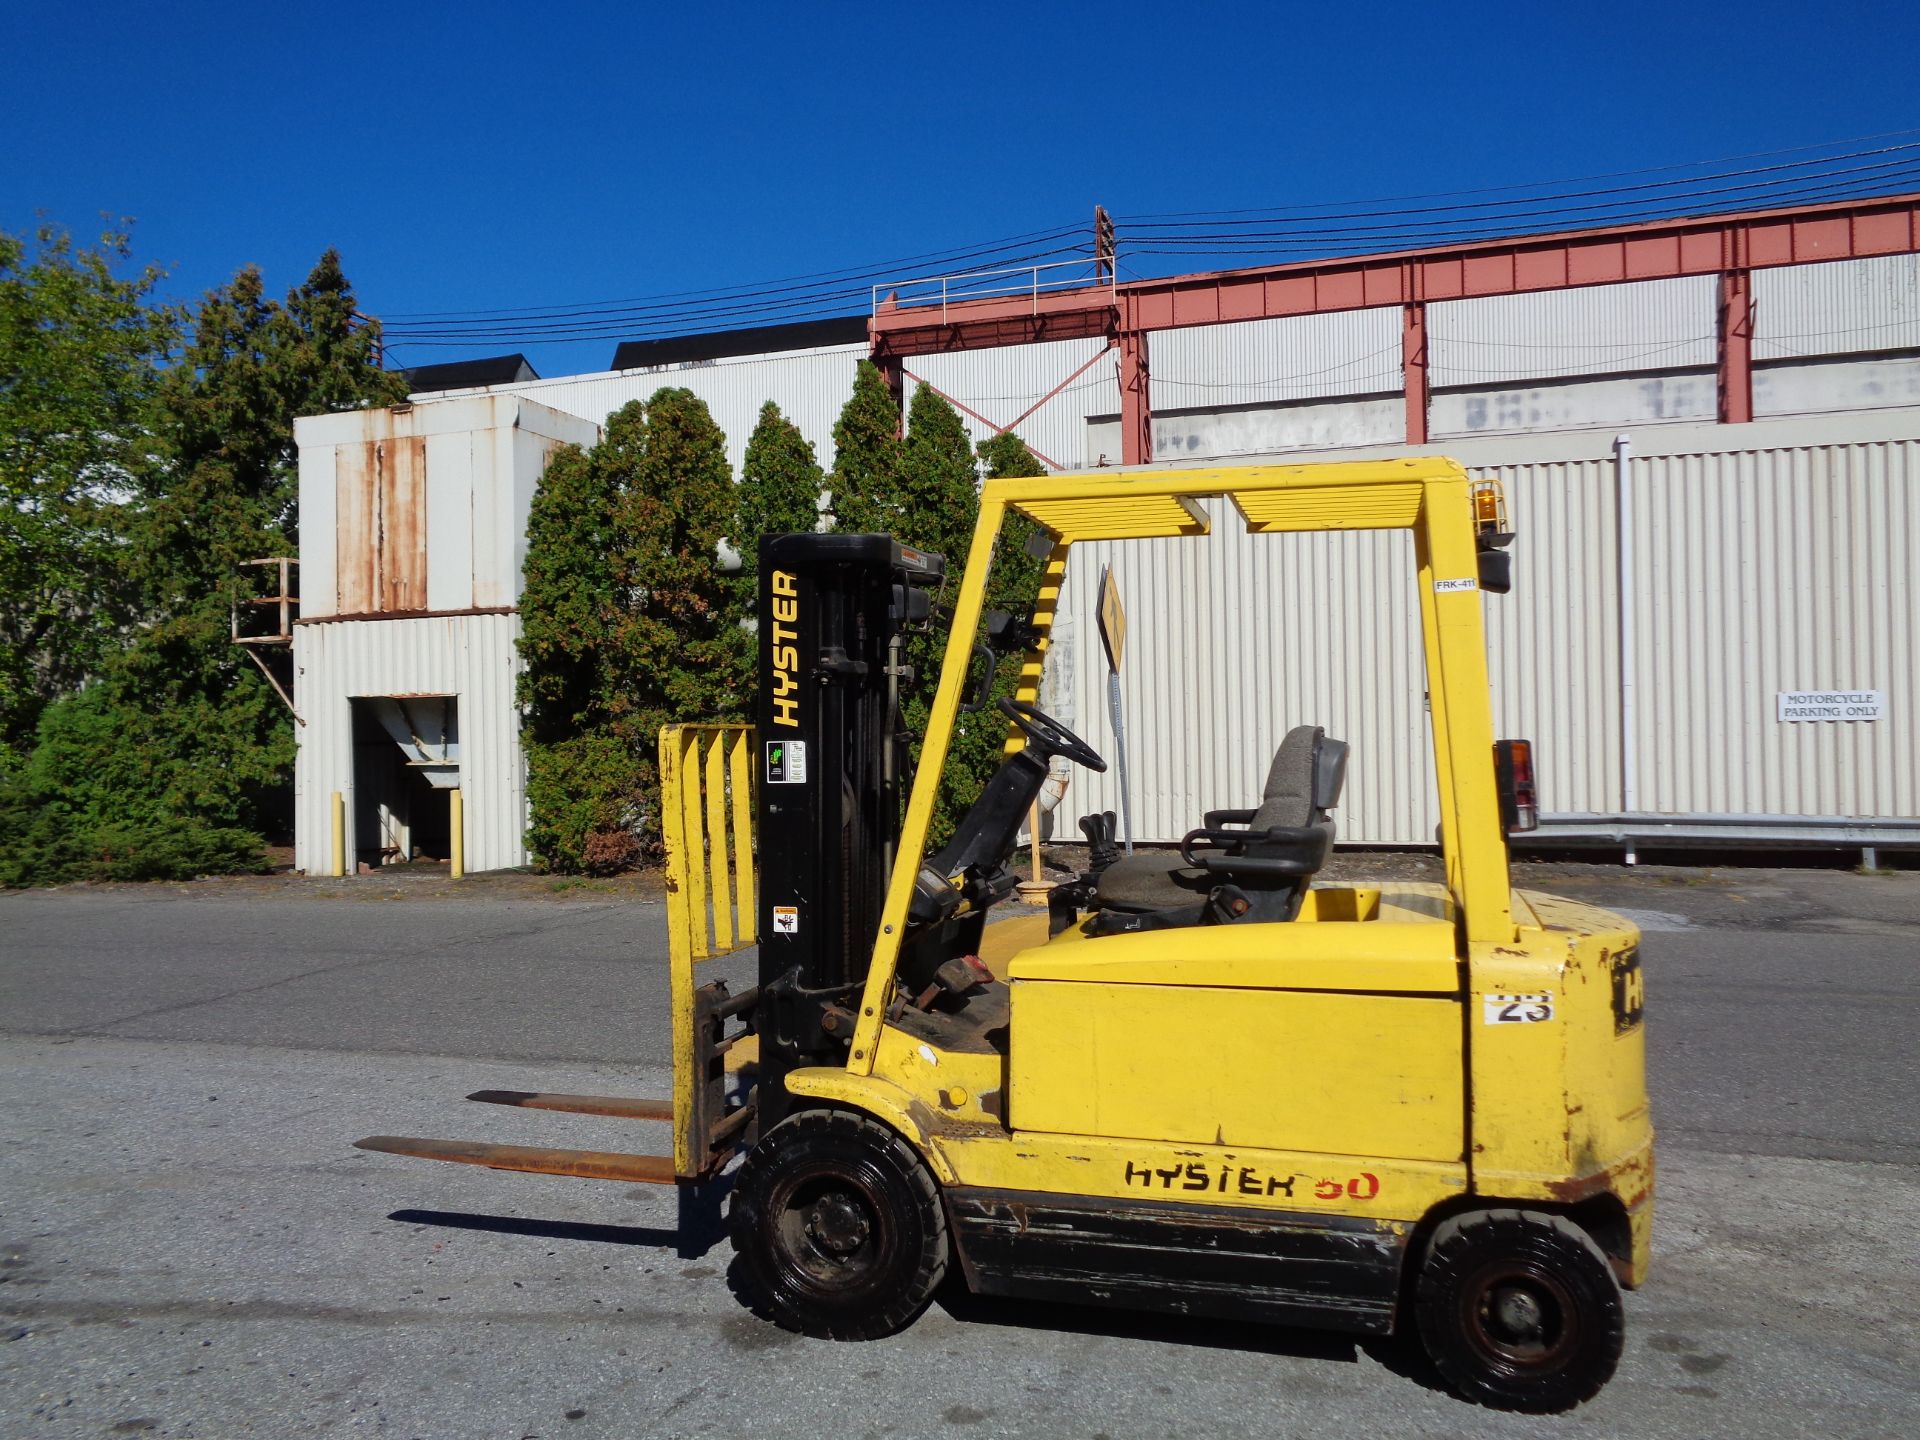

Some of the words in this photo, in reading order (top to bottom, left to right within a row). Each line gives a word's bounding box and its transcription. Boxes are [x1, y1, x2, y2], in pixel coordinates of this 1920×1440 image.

[772, 570, 799, 728] HYSTER
[1788, 694, 1873, 704] MOTORCYCLE
[1785, 707, 1841, 716] PARKING
[1846, 706, 1878, 716] ONLY
